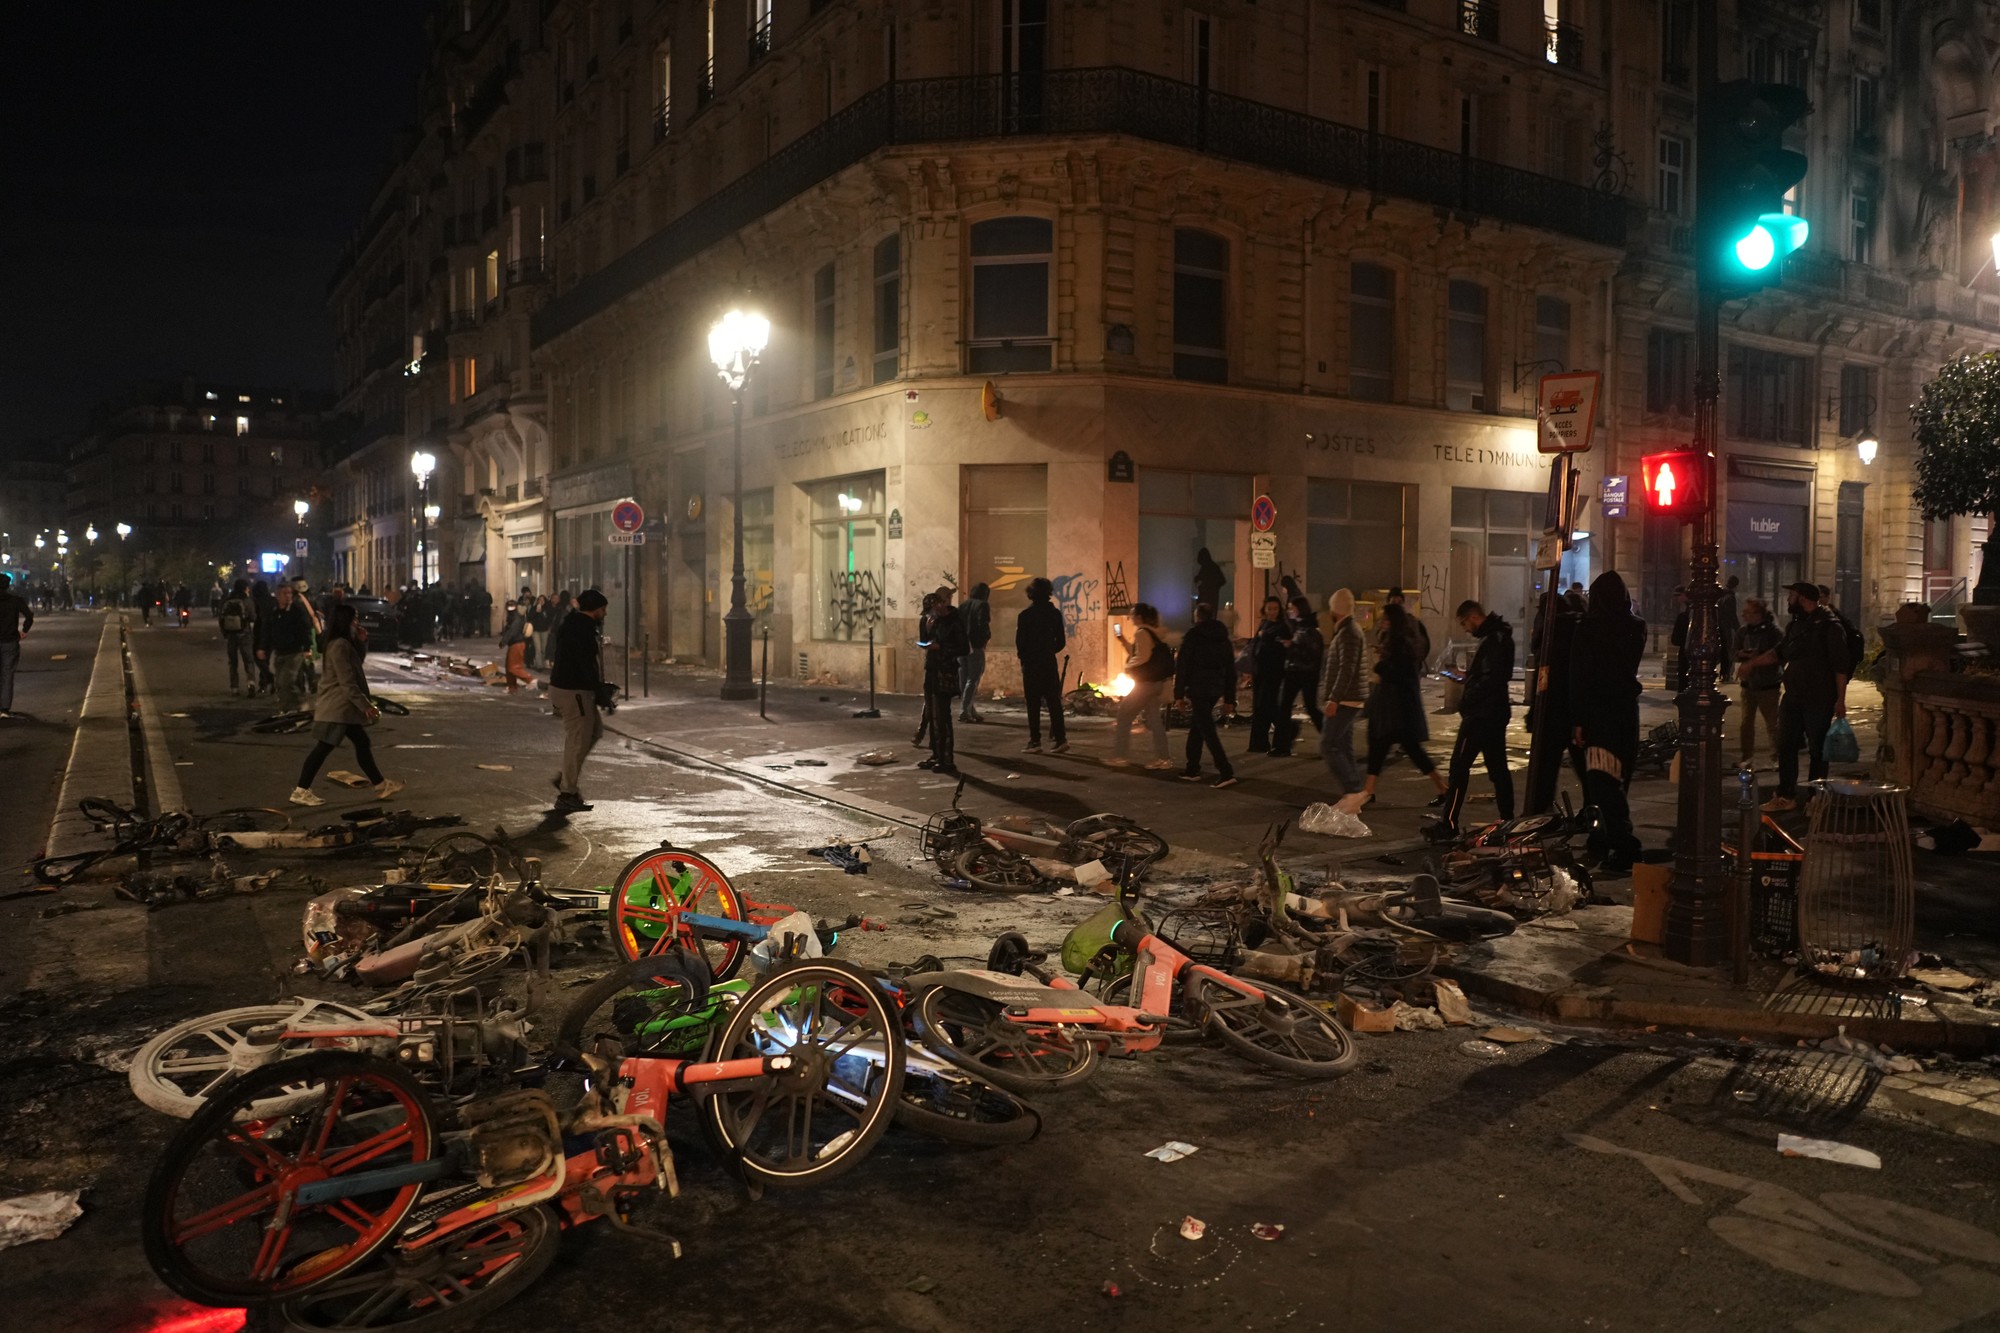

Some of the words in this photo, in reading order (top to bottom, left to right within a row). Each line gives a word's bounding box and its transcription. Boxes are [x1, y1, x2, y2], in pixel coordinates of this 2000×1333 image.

[1750, 516, 1781, 533] hubler
[612, 535, 632, 543] SAUF
[830, 569, 882, 599] MACRON
[410, 1198, 452, 1218] Moins
[417, 1206, 445, 1221] plus
